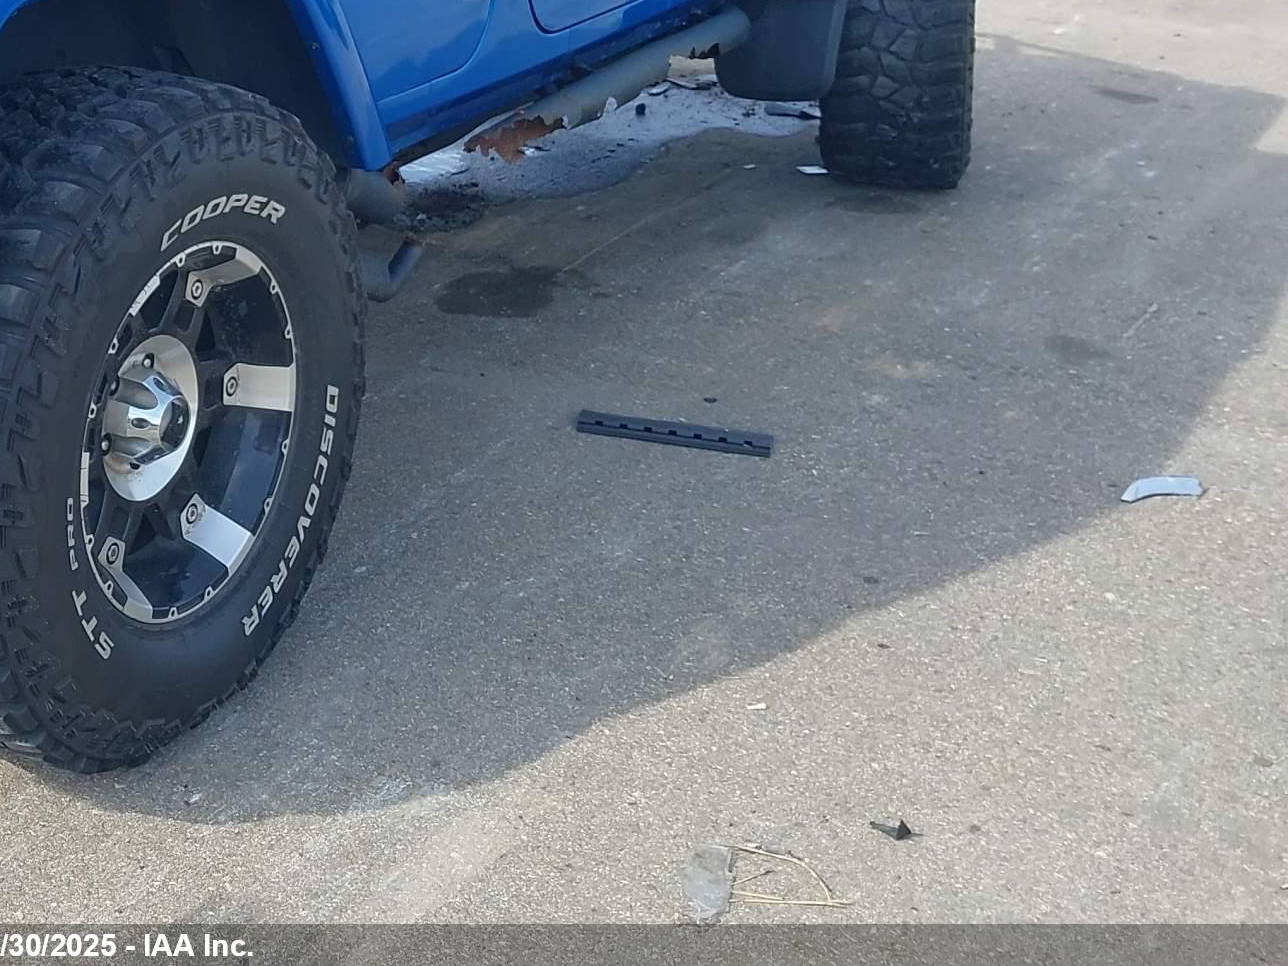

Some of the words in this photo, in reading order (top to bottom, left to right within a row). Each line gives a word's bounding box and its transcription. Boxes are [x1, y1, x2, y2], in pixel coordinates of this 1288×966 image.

[160, 193, 286, 253] COOPER
[66, 497, 79, 571] PRO
[241, 384, 340, 637] DISCOVERER
[72, 589, 115, 660] STT
